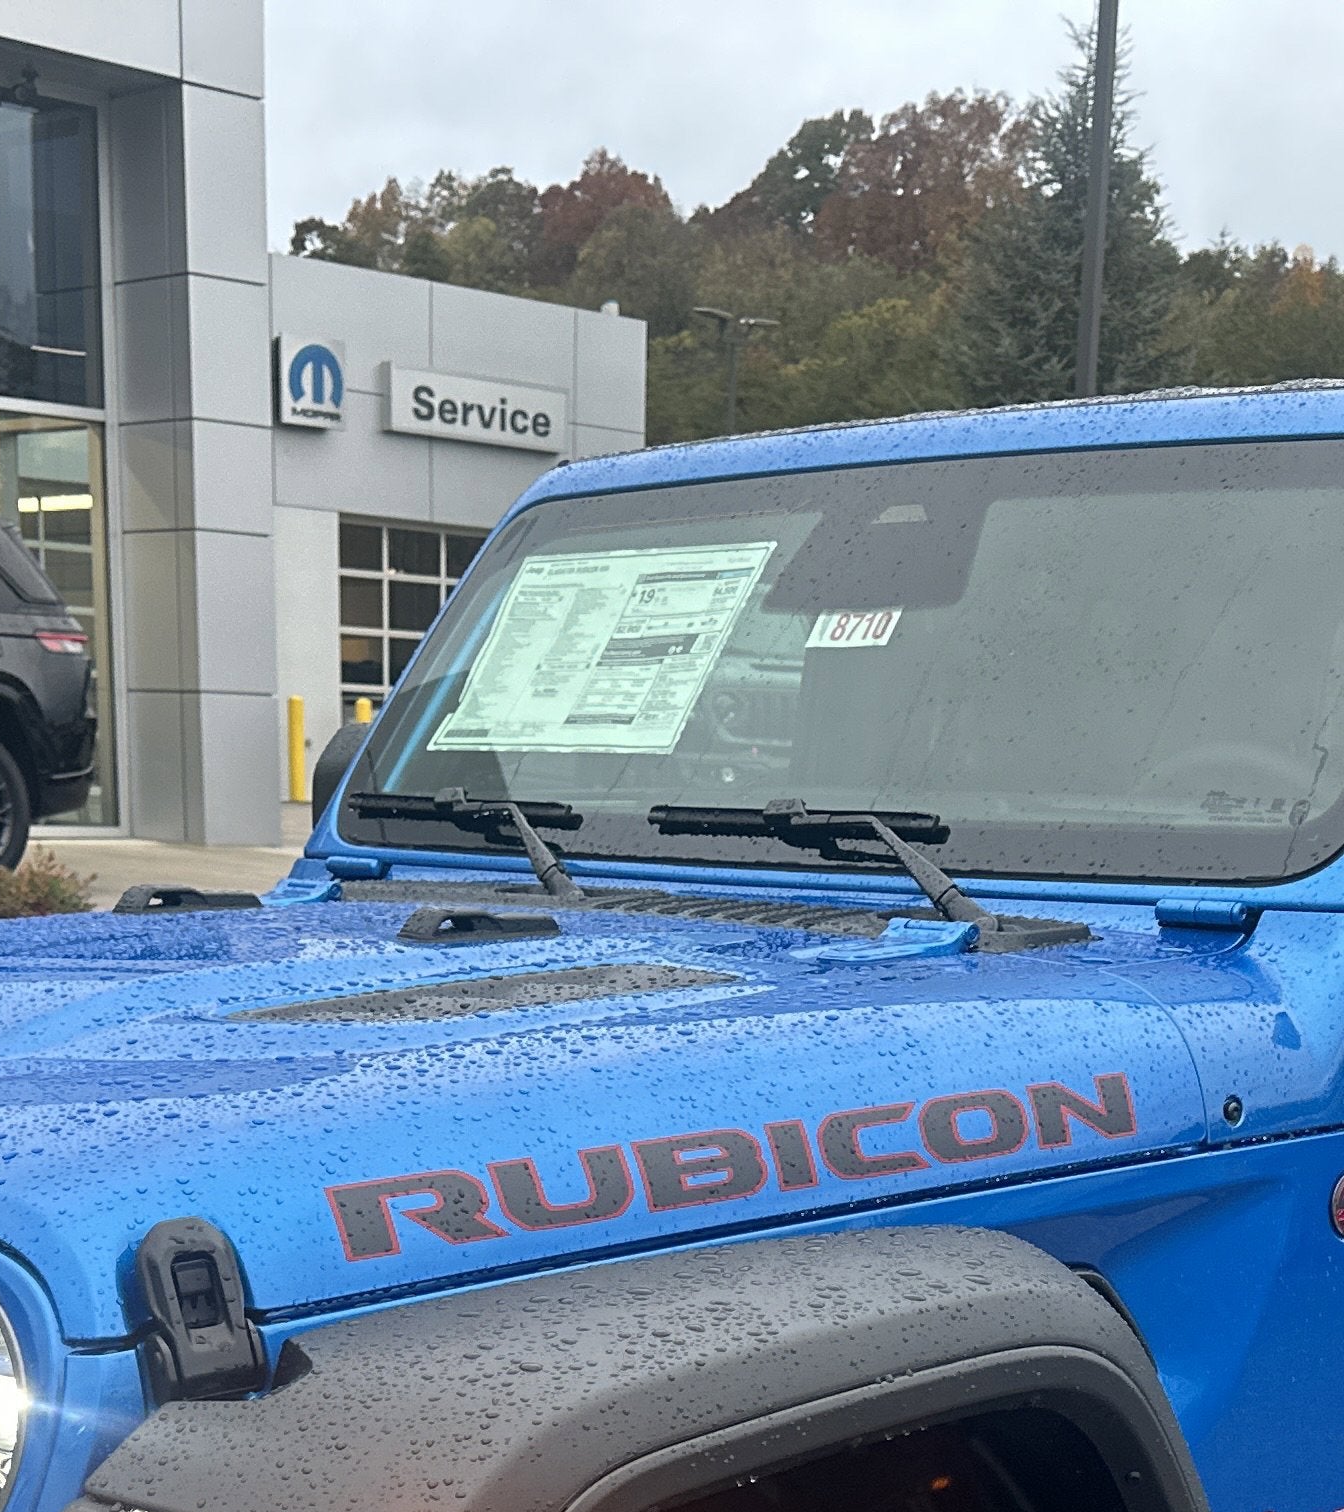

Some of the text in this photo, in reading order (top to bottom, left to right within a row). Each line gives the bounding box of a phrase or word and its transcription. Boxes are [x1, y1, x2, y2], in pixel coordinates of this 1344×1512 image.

[412, 385, 551, 438] Service
[638, 588, 656, 604] 19
[830, 611, 893, 641] 8710
[323, 1072, 1138, 1262] RUBICON
